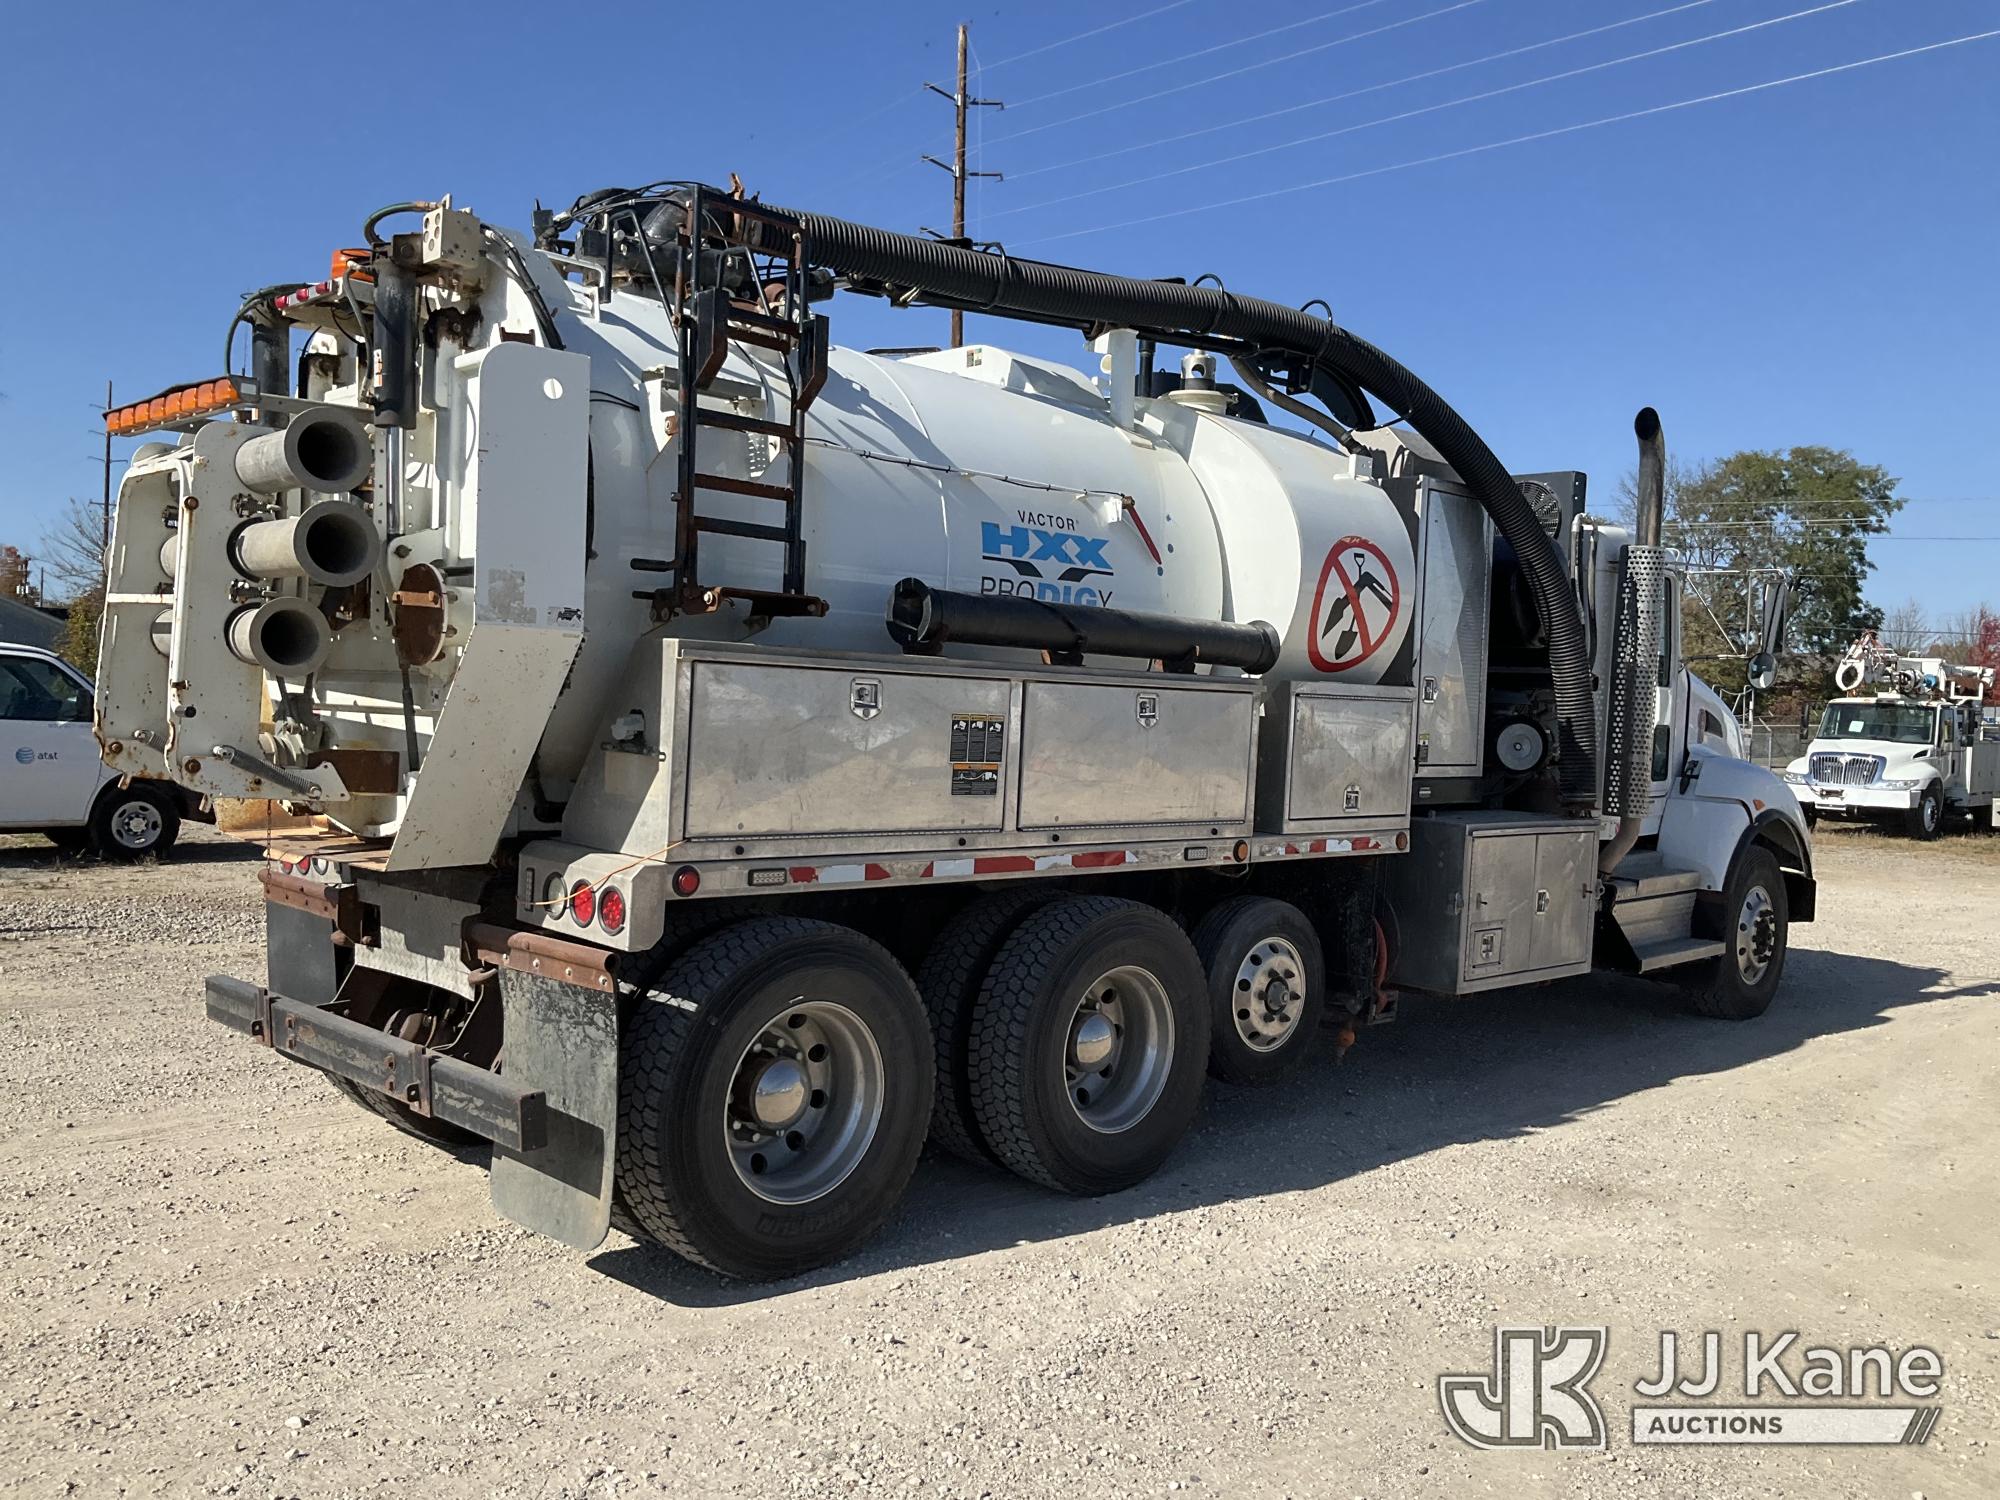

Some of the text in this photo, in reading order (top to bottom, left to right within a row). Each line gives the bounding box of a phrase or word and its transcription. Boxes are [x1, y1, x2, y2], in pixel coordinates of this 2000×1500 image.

[1017, 509, 1075, 531] VACTOR
[981, 521, 1112, 569] HXX
[980, 576, 1112, 607] PRODIGY
